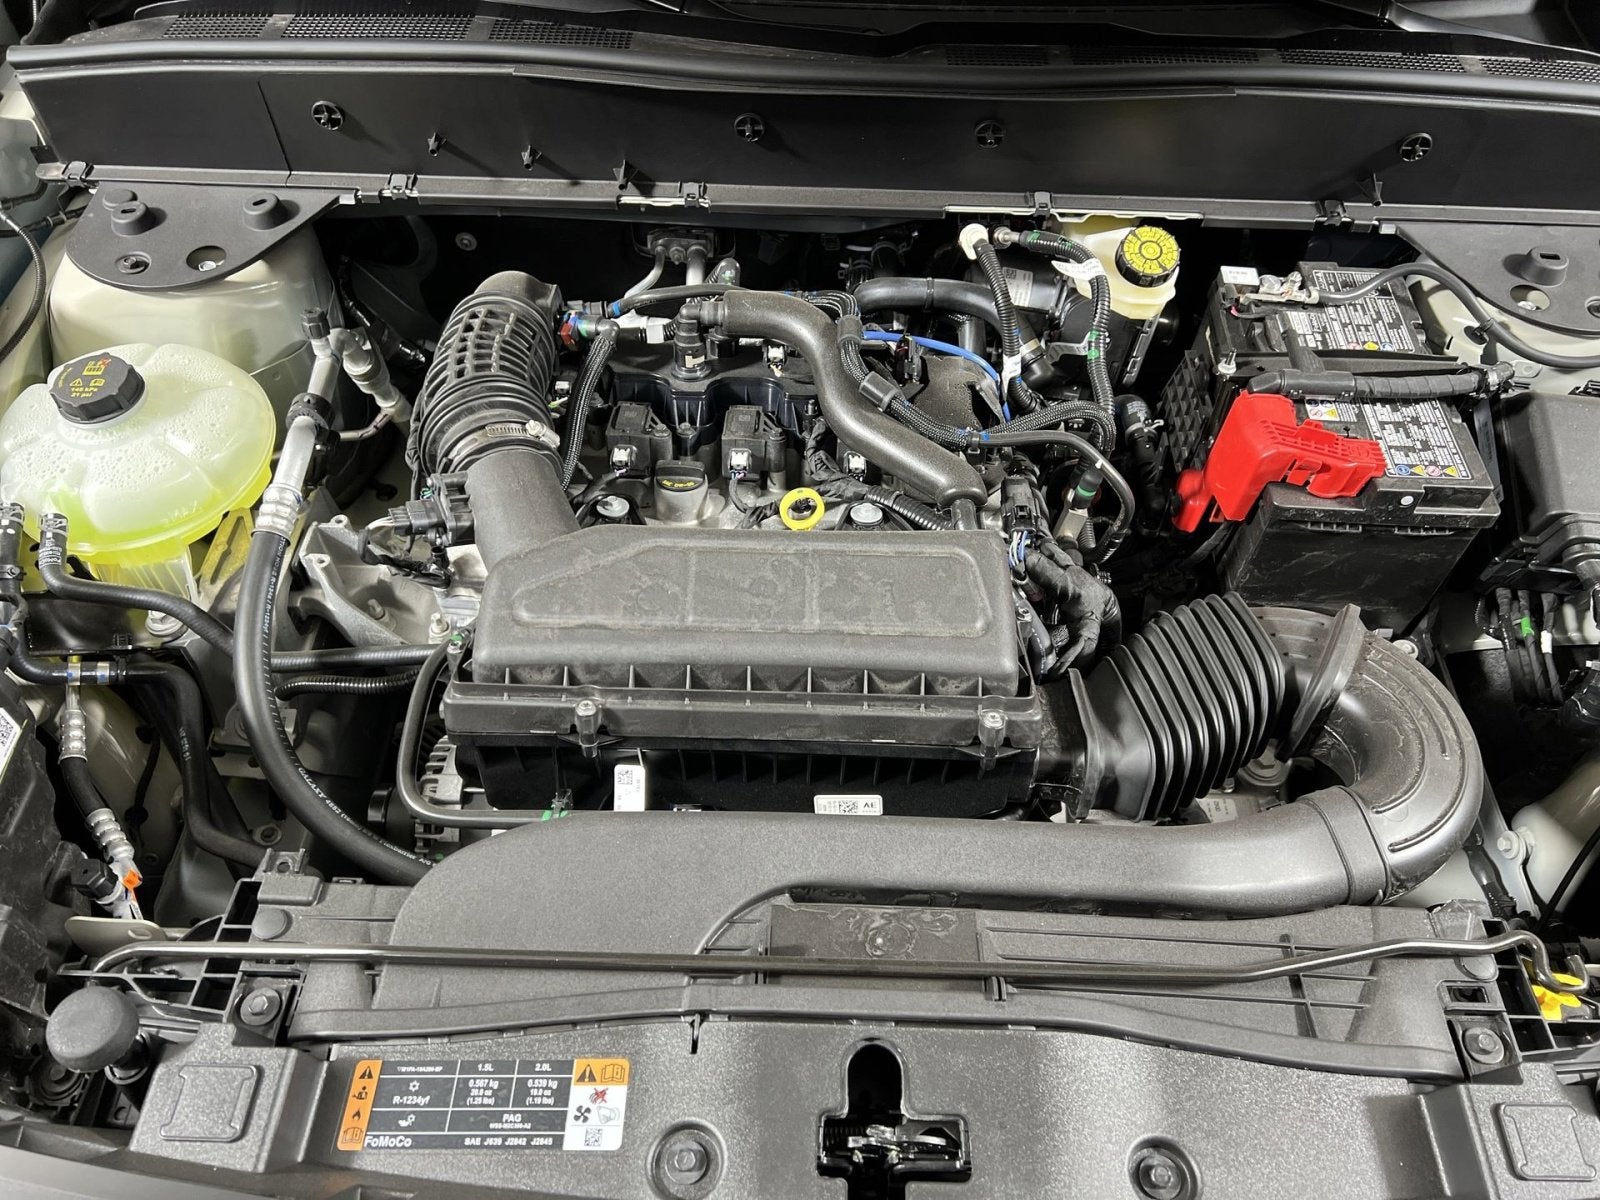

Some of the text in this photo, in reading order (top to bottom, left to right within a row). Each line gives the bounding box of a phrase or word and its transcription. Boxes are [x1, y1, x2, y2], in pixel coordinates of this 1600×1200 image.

[298, 767, 327, 799] GALAXY
[478, 1063, 494, 1072] 1.5L
[534, 1063, 552, 1072] 2.0L
[489, 1079, 499, 1089] kg
[548, 1079, 558, 1090] kg
[392, 1095, 430, 1106] R-1234yf
[502, 1114, 522, 1122] PAG
[364, 1136, 412, 1148] FoMoCo
[464, 1137, 482, 1146] SAE
